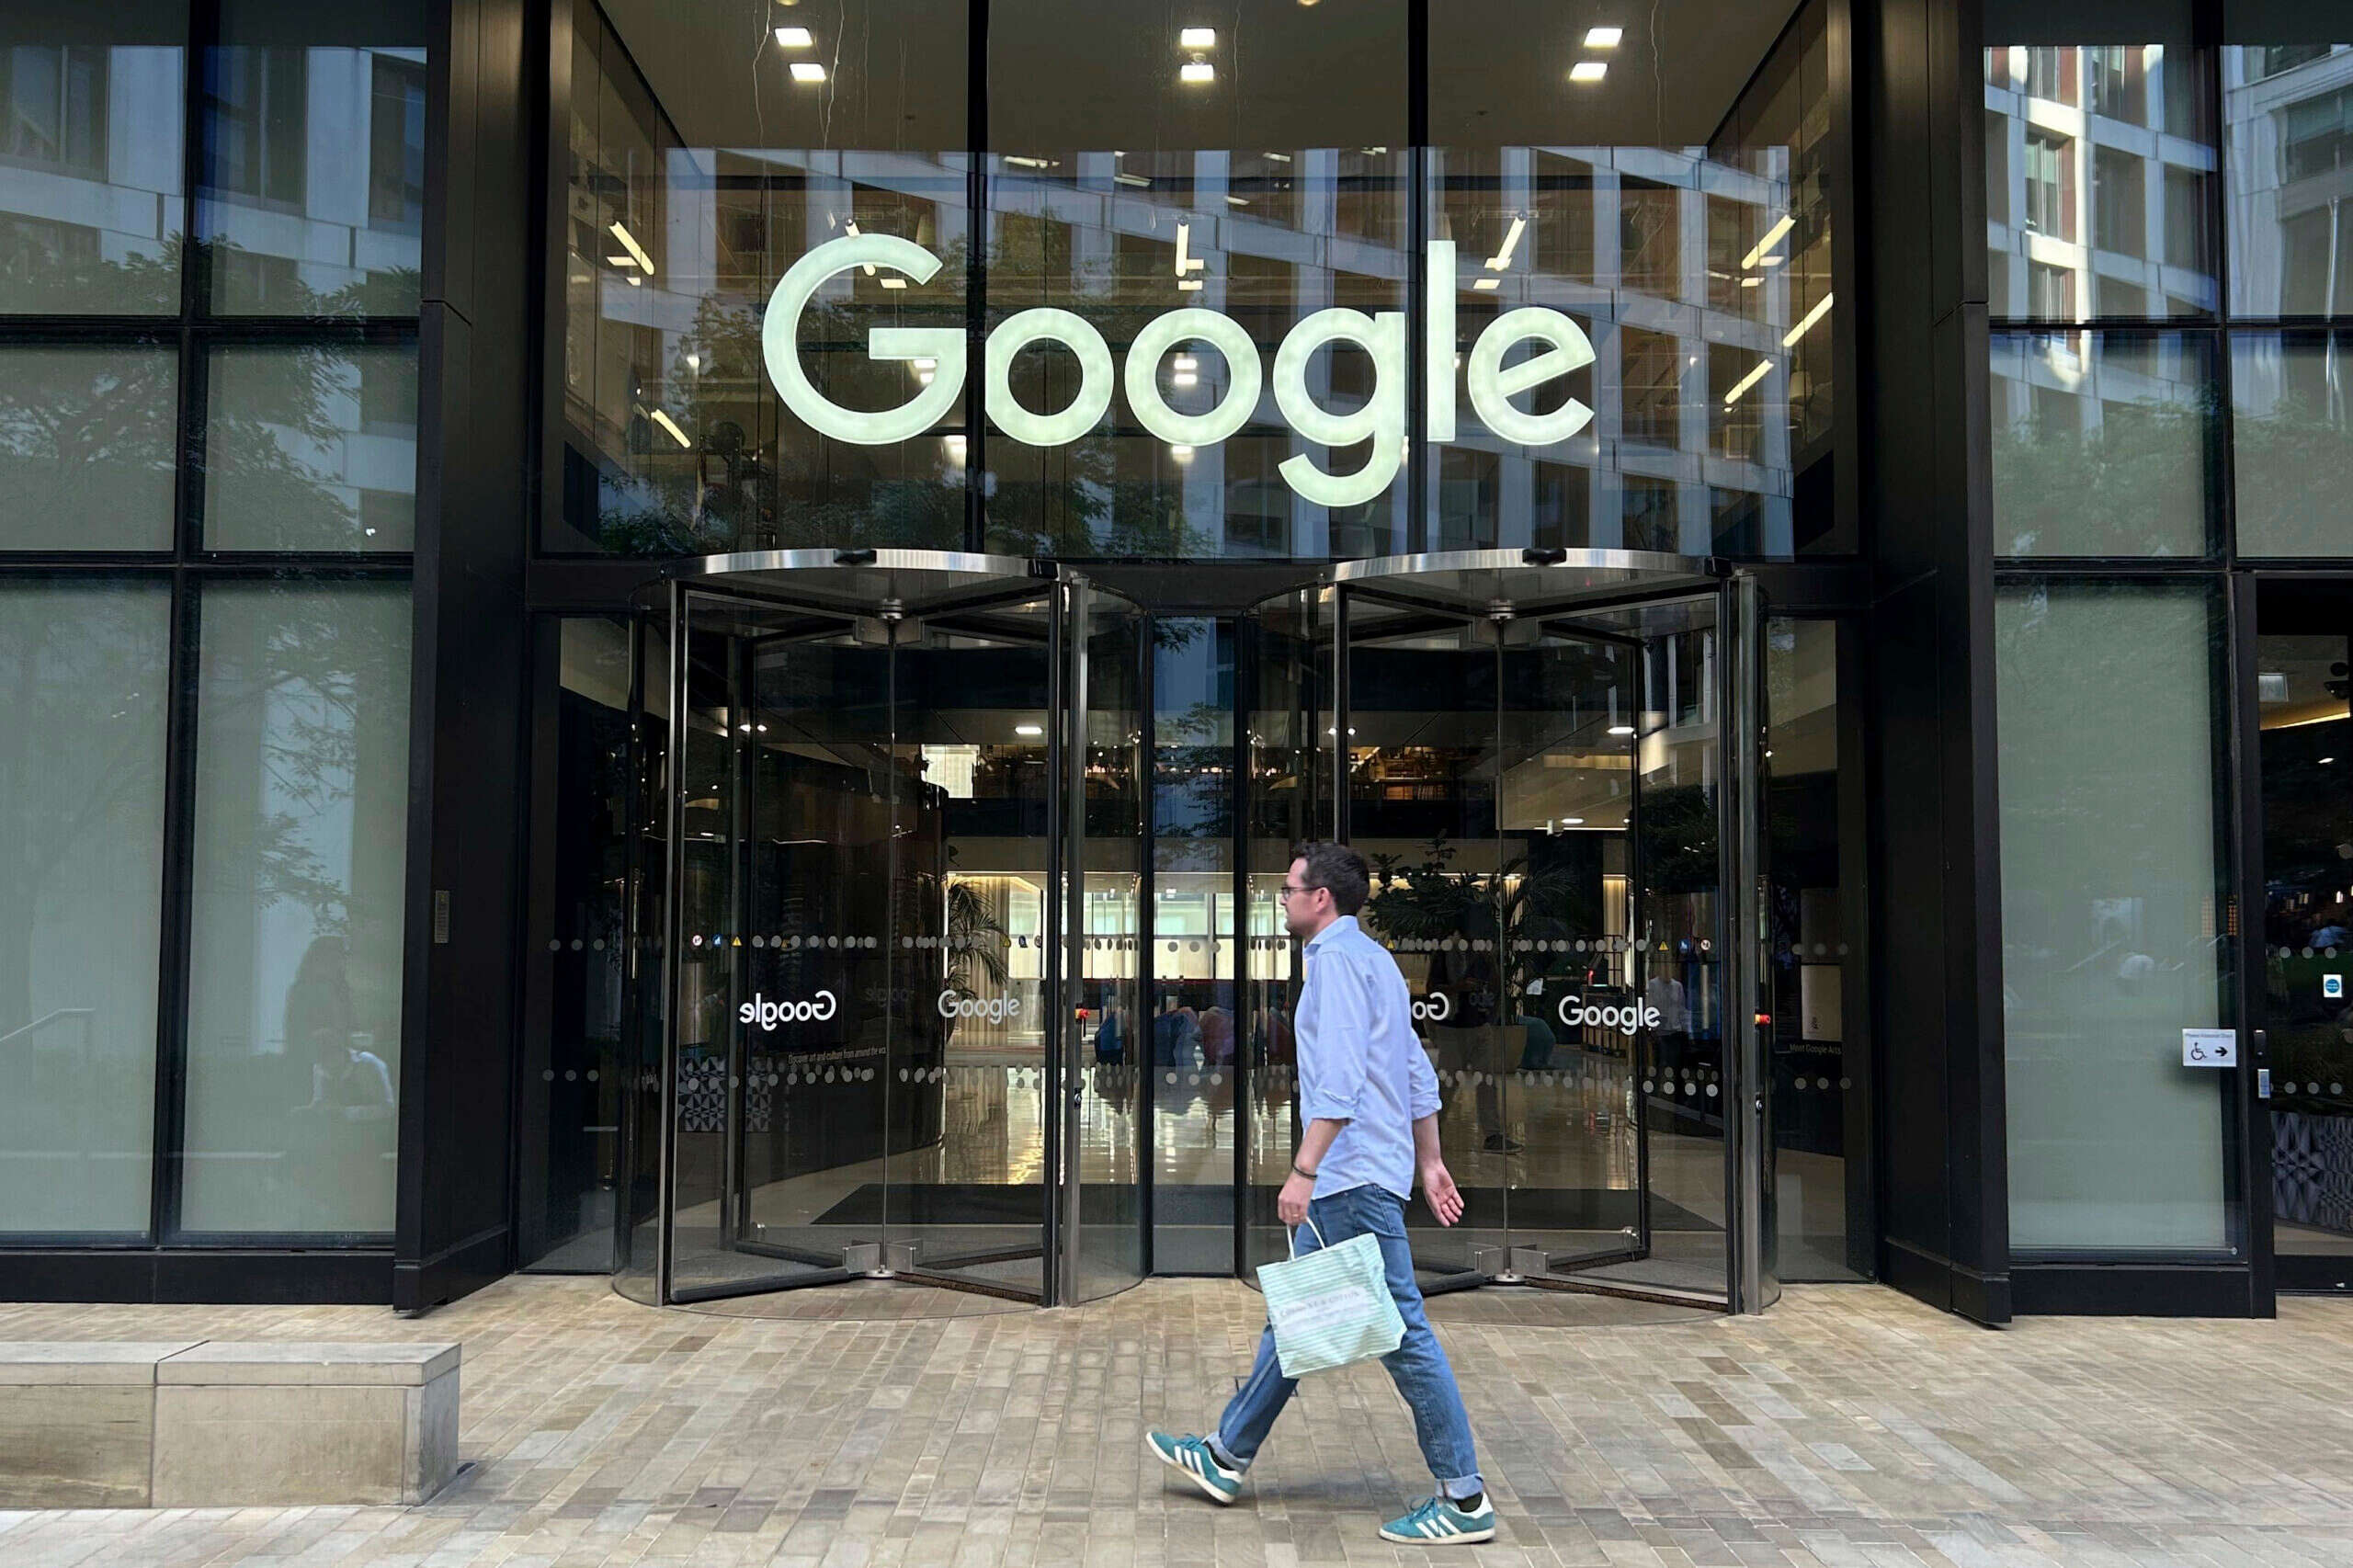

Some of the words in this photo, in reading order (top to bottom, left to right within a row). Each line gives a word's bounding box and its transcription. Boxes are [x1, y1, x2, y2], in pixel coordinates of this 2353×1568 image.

[763, 233, 1596, 506] Google
[938, 990, 1020, 1024] Google
[1558, 995, 1660, 1036] Google
